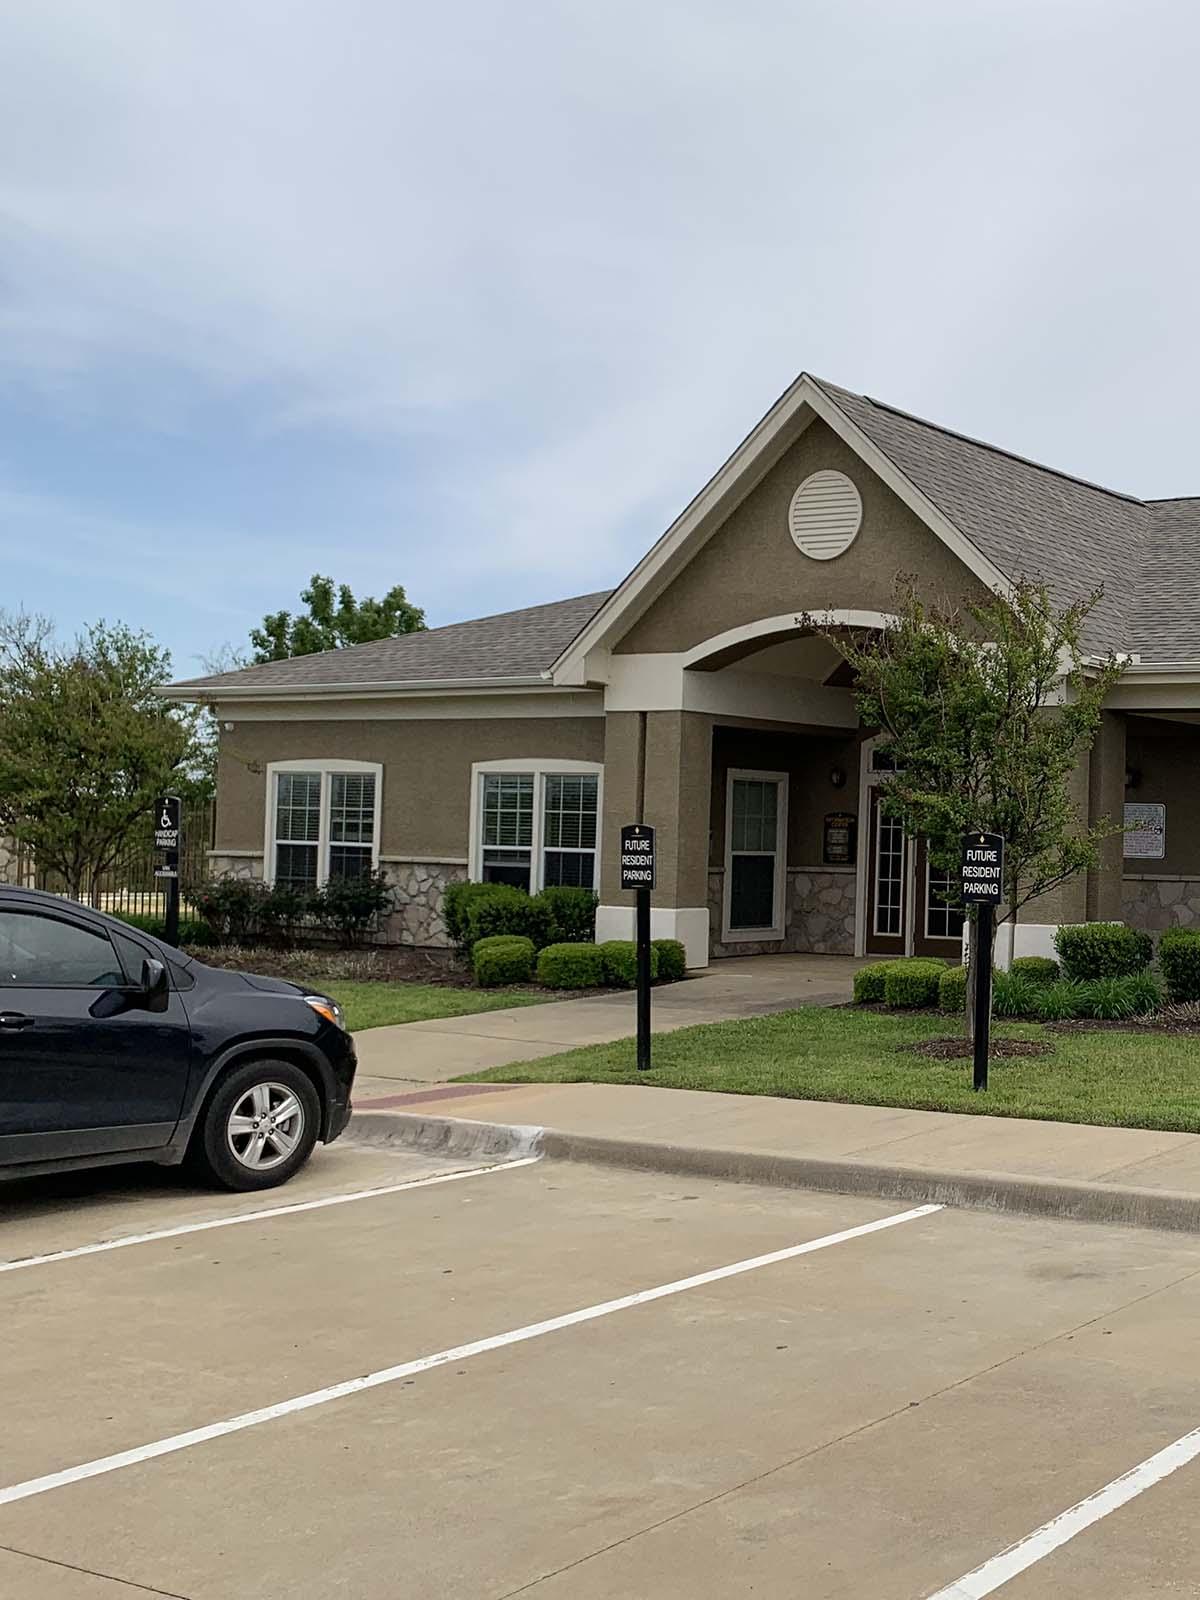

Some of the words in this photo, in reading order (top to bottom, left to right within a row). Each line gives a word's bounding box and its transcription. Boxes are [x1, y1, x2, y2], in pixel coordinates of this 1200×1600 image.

[624, 840, 650, 851] FUTURE
[622, 855, 653, 866] RESIDENT
[966, 849, 998, 862] FUTURE
[623, 870, 652, 881] PARKING
[962, 866, 1001, 878] RESIDENT
[963, 882, 999, 895] PARKING
